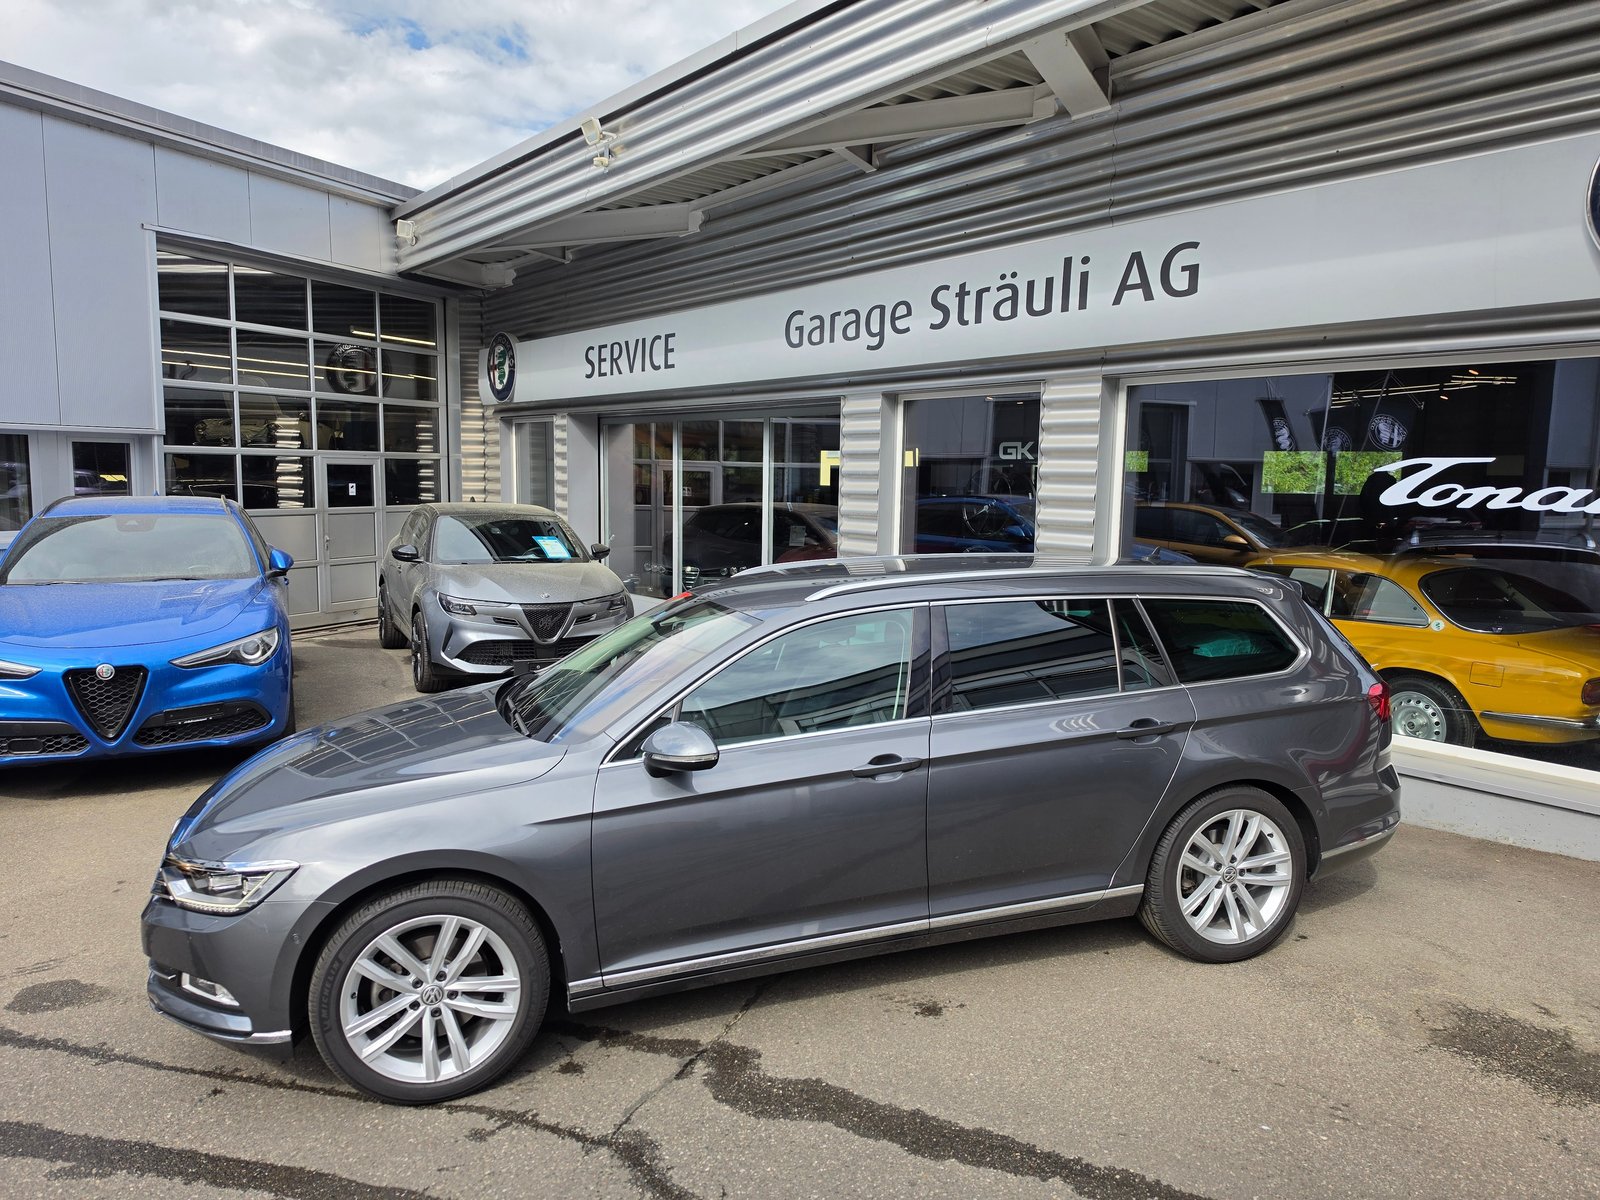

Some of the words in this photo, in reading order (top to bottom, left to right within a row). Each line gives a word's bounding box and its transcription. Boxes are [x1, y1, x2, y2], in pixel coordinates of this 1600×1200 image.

[785, 300, 912, 351] Garage
[929, 255, 1091, 330] Sträuli
[1112, 241, 1200, 306] AG
[585, 333, 676, 379] SERVICE
[999, 441, 1035, 460] GK
[1374, 457, 1600, 514] Tona
[321, 961, 340, 1018] MICHELIN
